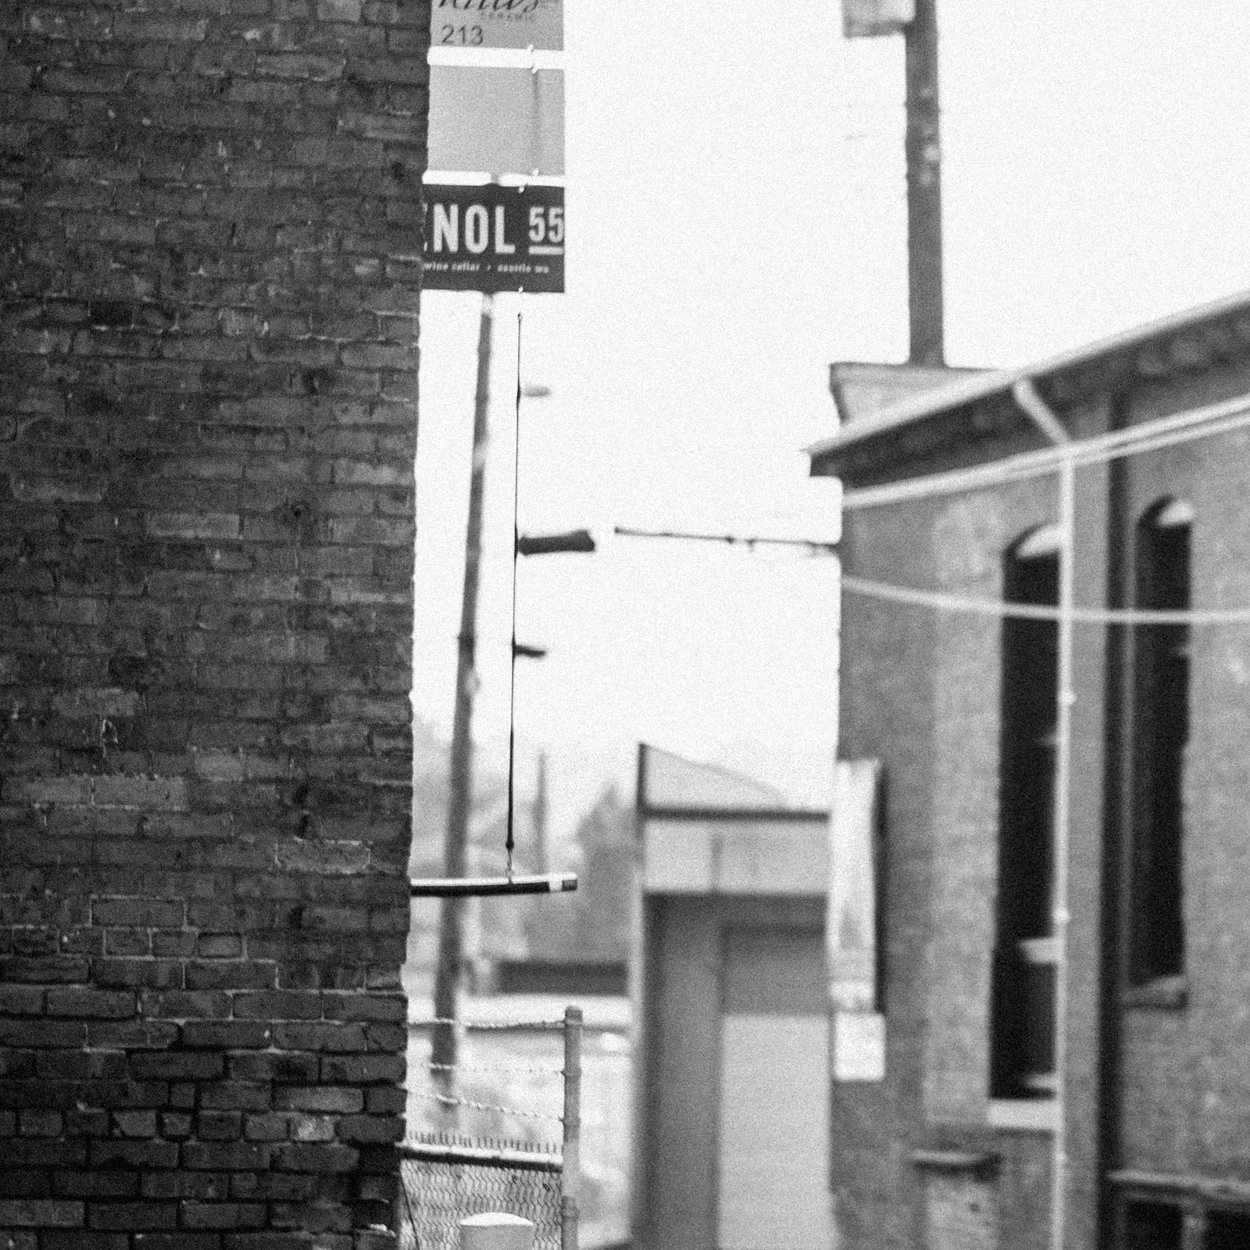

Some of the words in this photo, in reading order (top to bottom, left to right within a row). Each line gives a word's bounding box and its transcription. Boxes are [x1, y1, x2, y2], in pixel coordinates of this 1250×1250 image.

[441, 24, 484, 46] 213
[423, 203, 516, 255] NOL
[528, 206, 565, 243] 55
